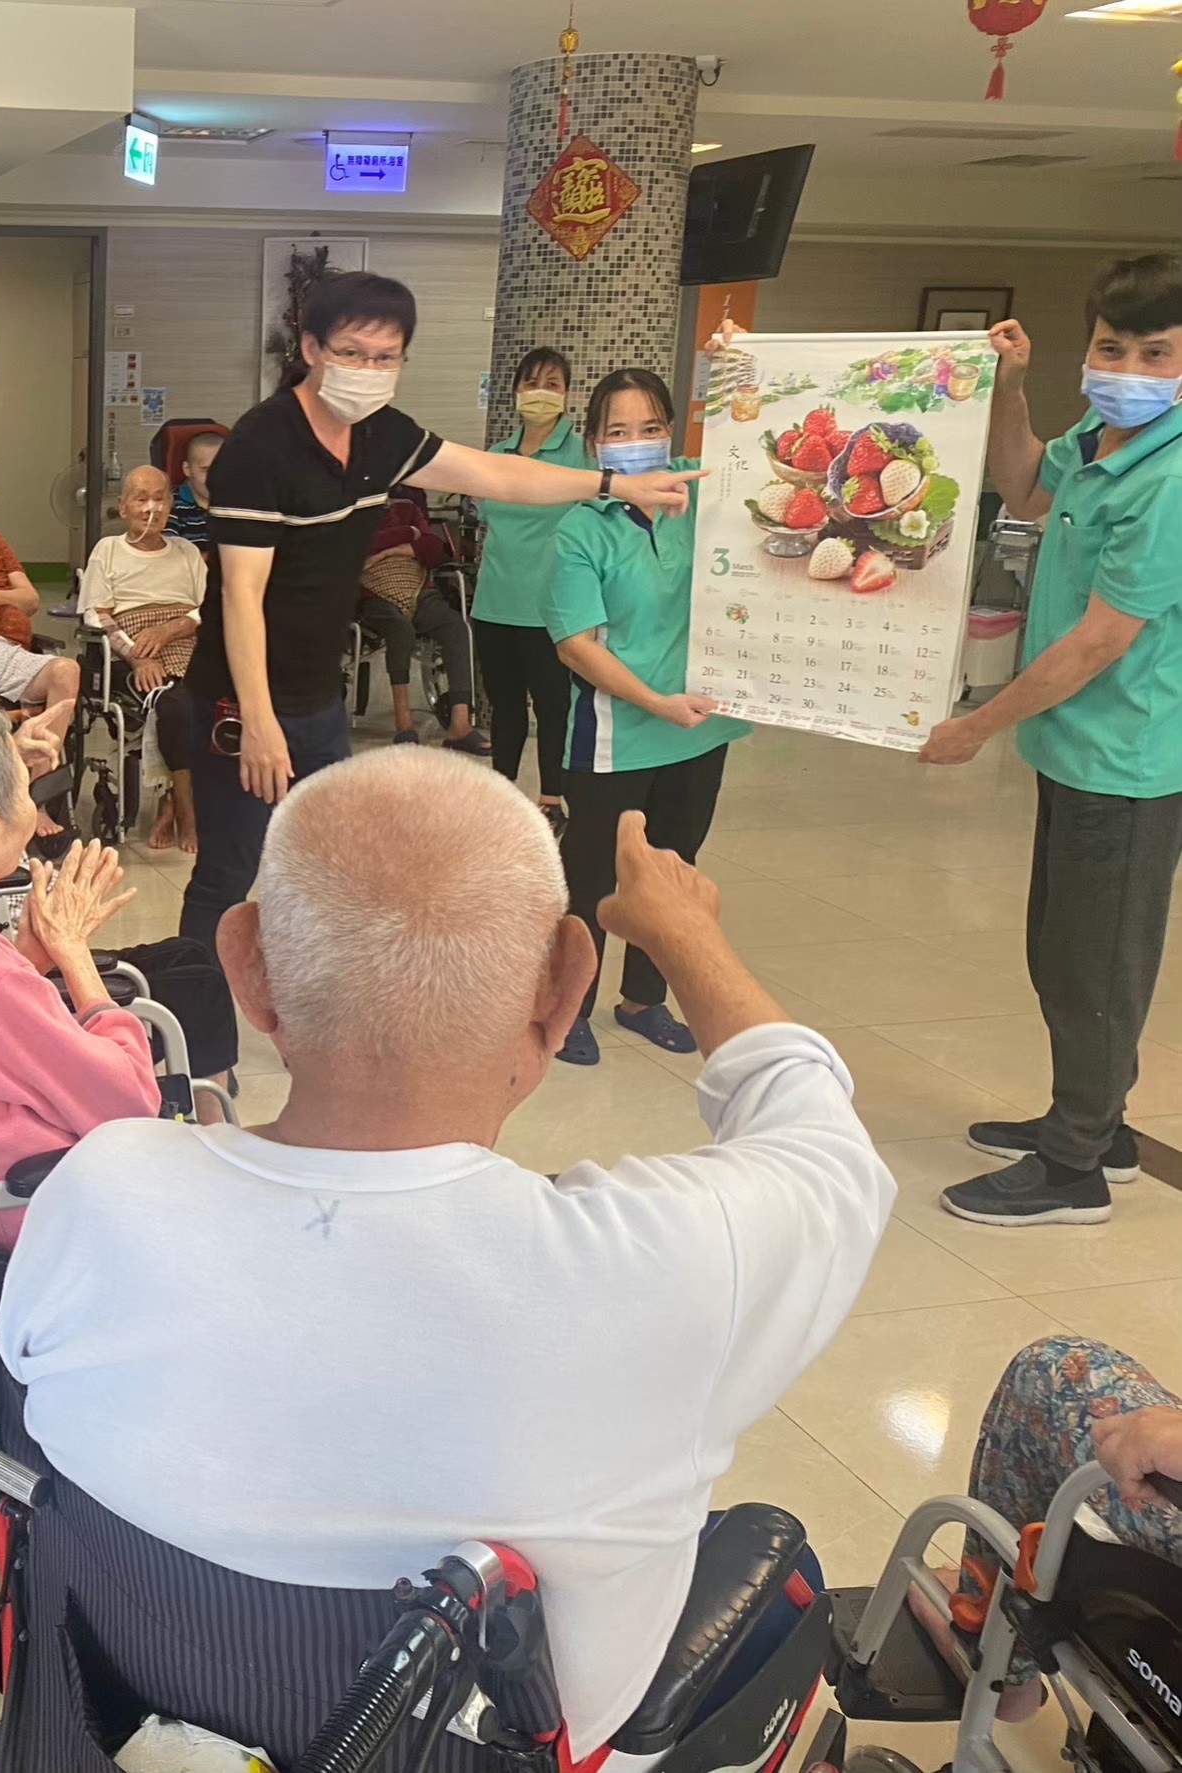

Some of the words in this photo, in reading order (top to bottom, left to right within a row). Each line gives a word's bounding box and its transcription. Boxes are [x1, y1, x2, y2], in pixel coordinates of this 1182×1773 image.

[710, 548, 730, 576] 3
[810, 615, 816, 625] 2
[845, 619, 852, 628] 3
[883, 622, 889, 632] 4
[921, 625, 928, 635] 5
[706, 627, 712, 636] 6
[739, 630, 746, 639] 7
[773, 633, 779, 643] 8
[808, 636, 815, 646] 9
[842, 640, 853, 650] 10
[879, 644, 889, 654] 11
[917, 647, 928, 657] 12
[705, 646, 714, 656] 13
[738, 650, 748, 659] 14
[772, 653, 781, 663] 15
[806, 658, 816, 667] 16
[841, 661, 851, 671] 17
[877, 666, 888, 675] 18
[914, 670, 925, 680] 19
[702, 666, 714, 676] 20
[736, 669, 747, 679] 21
[770, 673, 781, 684] 22
[803, 678, 815, 688] 23
[838, 683, 850, 692] 24
[874, 687, 886, 697] 25
[910, 692, 922, 702] 26
[702, 687, 713, 695] 27
[736, 690, 747, 699] 28
[769, 694, 780, 704] 29
[802, 699, 814, 709] 30
[836, 704, 847, 714] 31
[1126, 1648, 1182, 1717] soma
